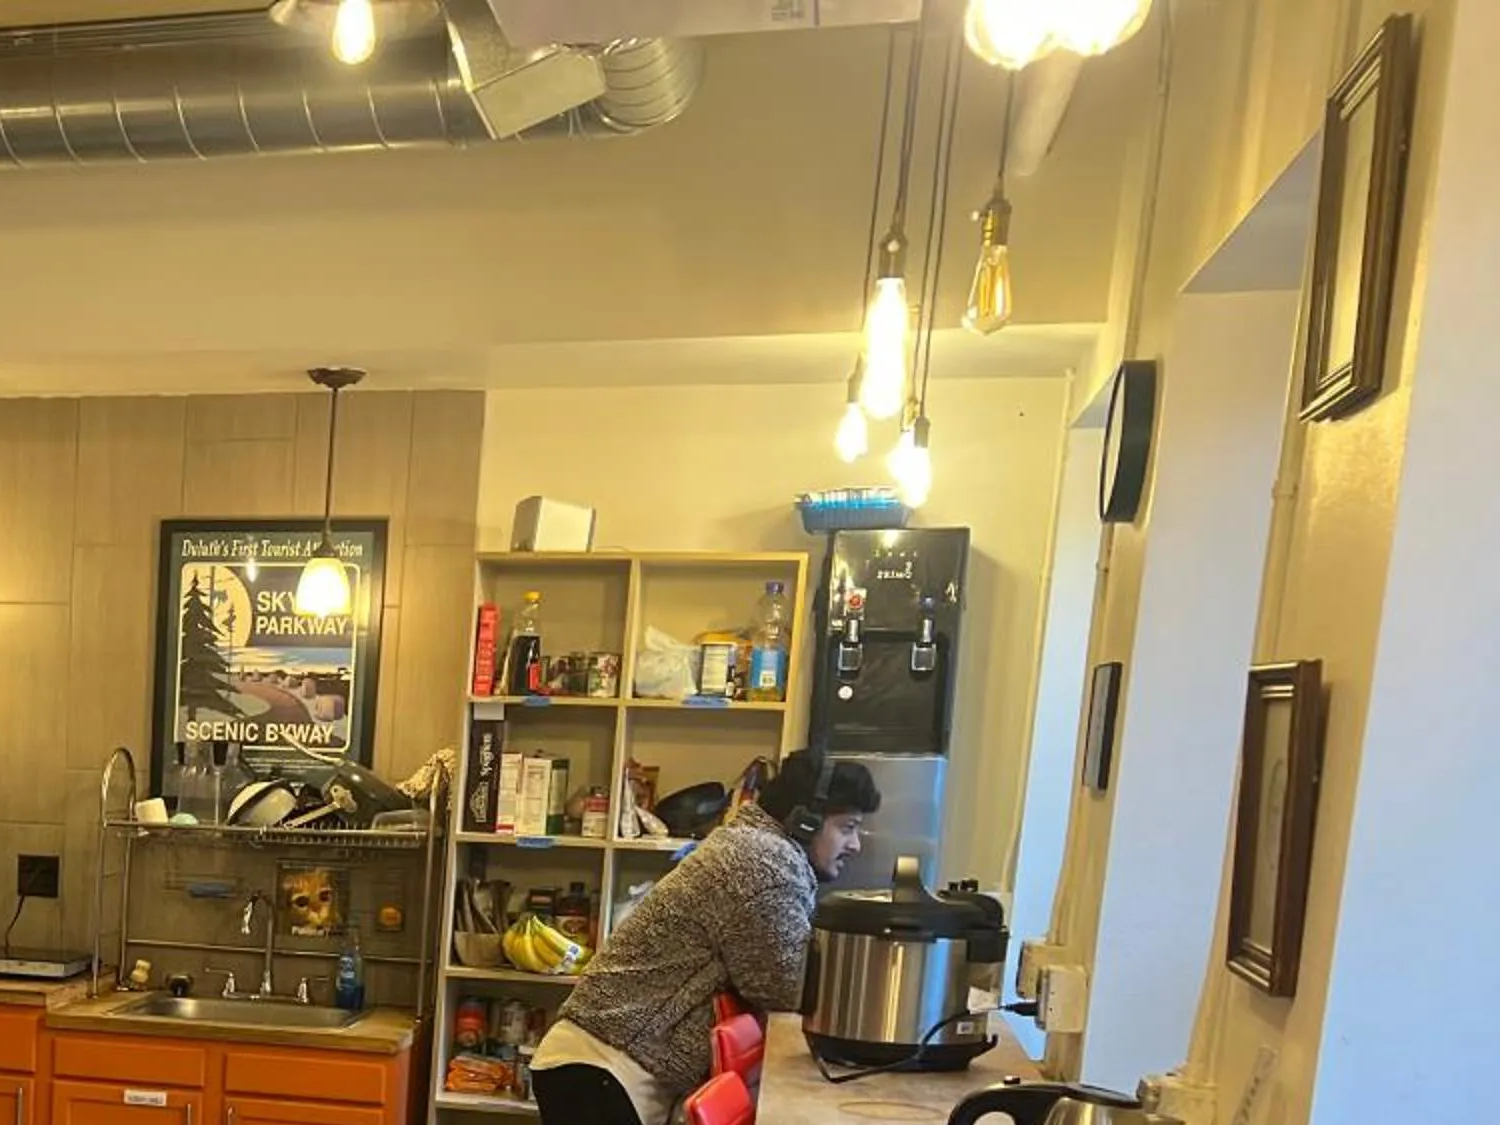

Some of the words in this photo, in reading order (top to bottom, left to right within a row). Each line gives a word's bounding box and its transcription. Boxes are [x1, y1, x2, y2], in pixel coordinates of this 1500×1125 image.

[182, 539, 228, 557] Duluth's
[231, 539, 259, 557] First
[261, 540, 301, 557] Tourist
[256, 615, 348, 635] PARKWAY
[185, 721, 259, 742] SCENIC
[265, 722, 334, 743] BYWAY
